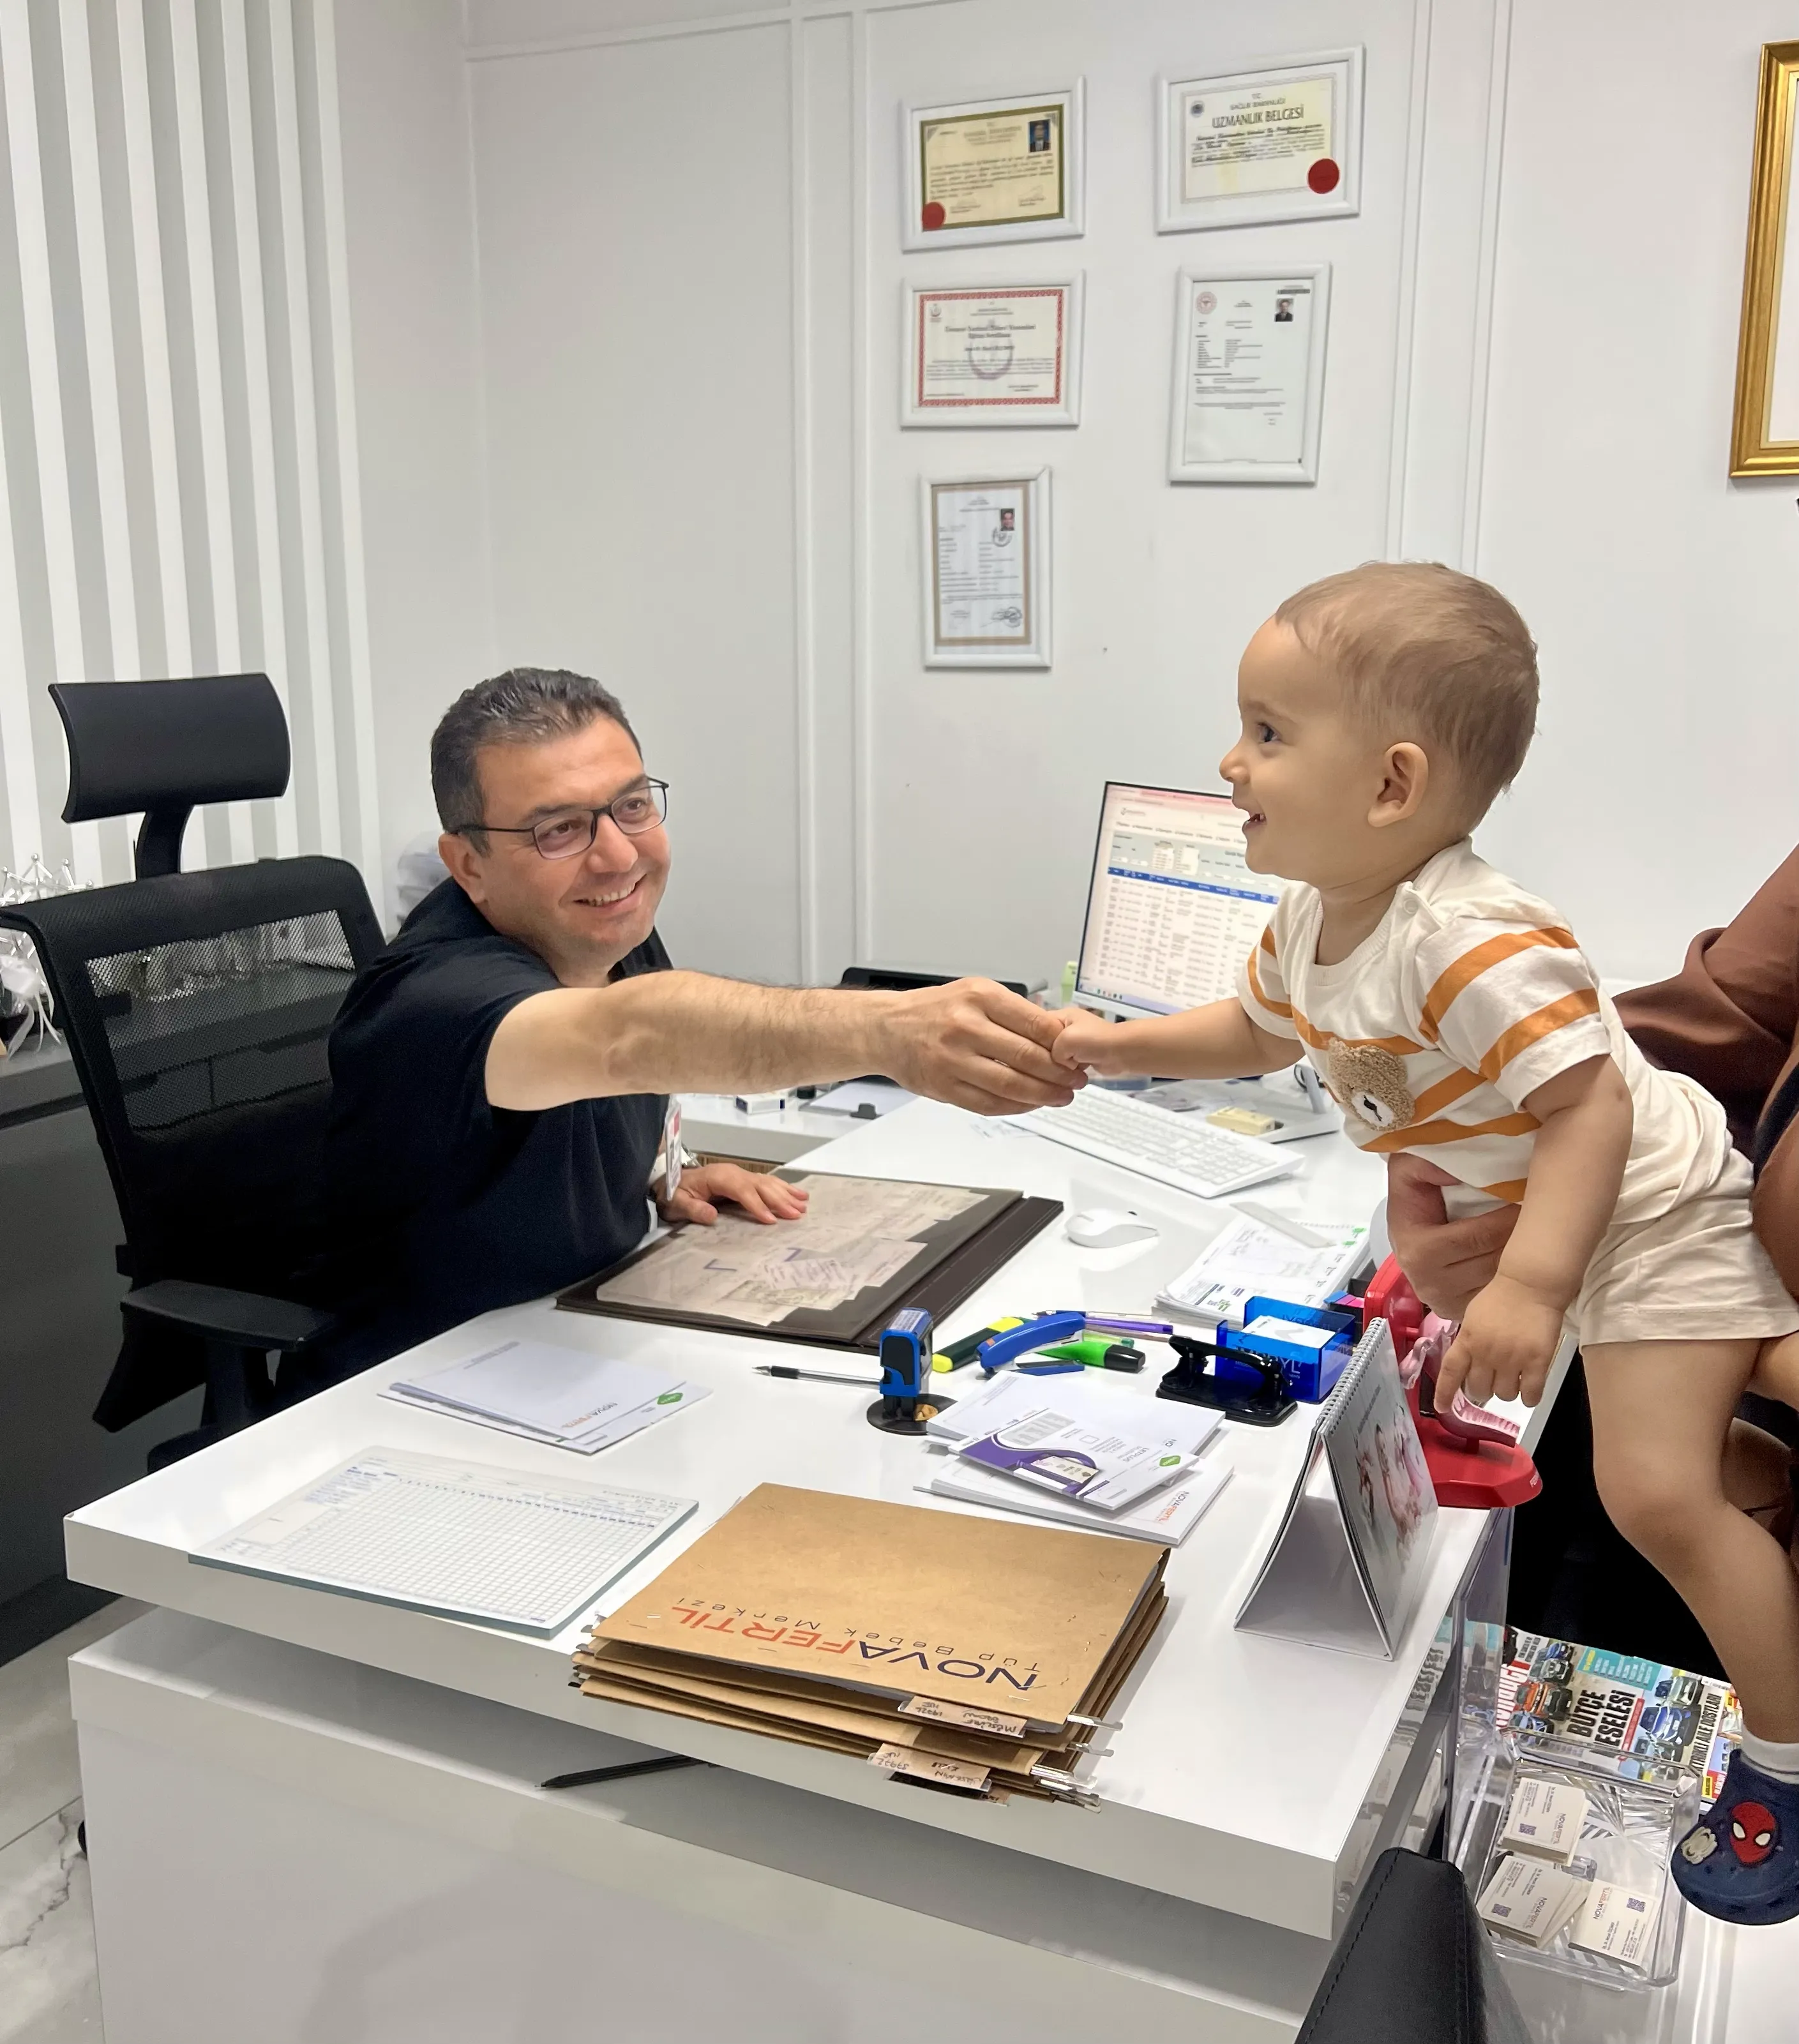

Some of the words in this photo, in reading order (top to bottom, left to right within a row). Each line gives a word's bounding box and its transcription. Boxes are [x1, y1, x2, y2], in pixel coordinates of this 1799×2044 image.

[1212, 112, 1263, 128] UZMANLIK
[1265, 103, 1304, 123] BELGESİ
[679, 1597, 821, 1632] Merkezi
[671, 1606, 1036, 1691] NOVAFERTİL
[843, 1627, 954, 1657] Bebek
[979, 1653, 1042, 1674] Tüp
